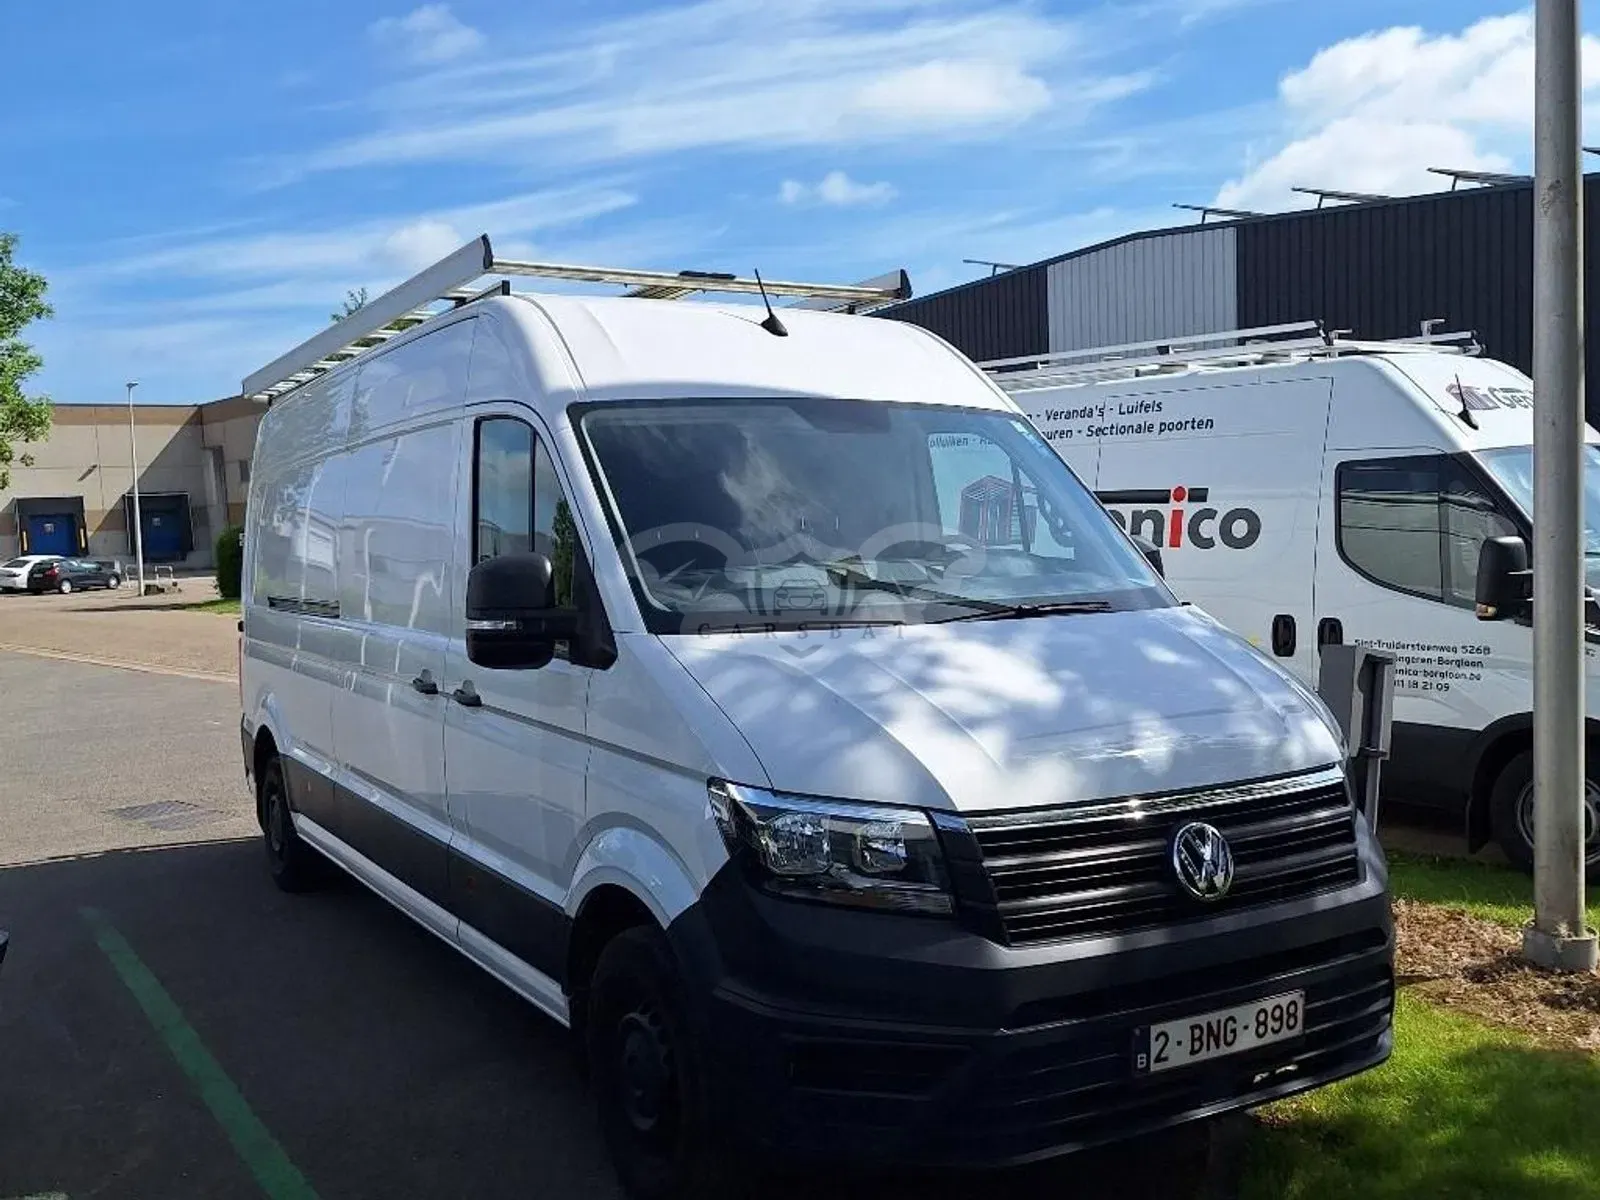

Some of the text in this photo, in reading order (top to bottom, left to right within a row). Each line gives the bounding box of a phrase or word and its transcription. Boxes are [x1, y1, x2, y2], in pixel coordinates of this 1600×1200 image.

[1045, 405, 1104, 421] Veranda's
[1118, 401, 1162, 415] Luifels
[1086, 421, 1154, 437] Sectionale
[1158, 418, 1214, 435] poorten
[1137, 1053, 1147, 1069] B
